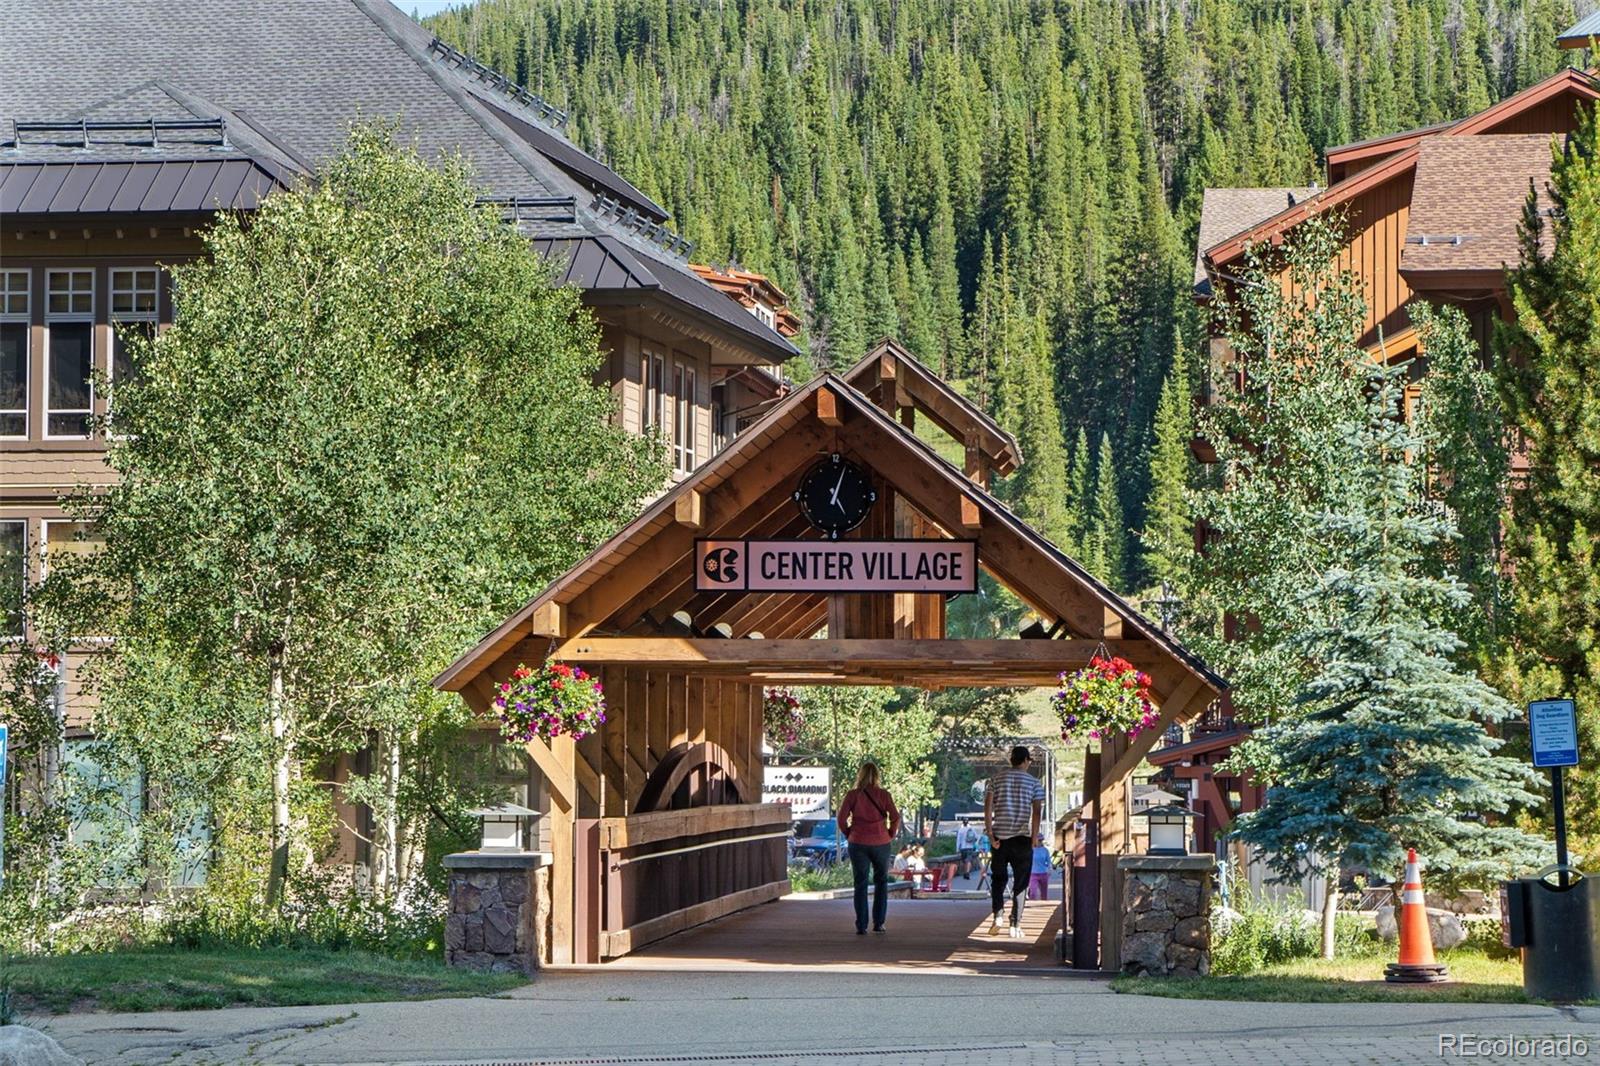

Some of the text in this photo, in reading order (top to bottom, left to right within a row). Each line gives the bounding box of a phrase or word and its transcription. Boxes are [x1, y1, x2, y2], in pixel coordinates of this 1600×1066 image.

[831, 453, 840, 463] 12
[794, 492, 800, 501] 9
[870, 492, 876, 501] 3
[832, 530, 838, 539] 6
[760, 551, 963, 581] CENTER VILLAGE
[788, 785, 828, 794] DIAMOND
